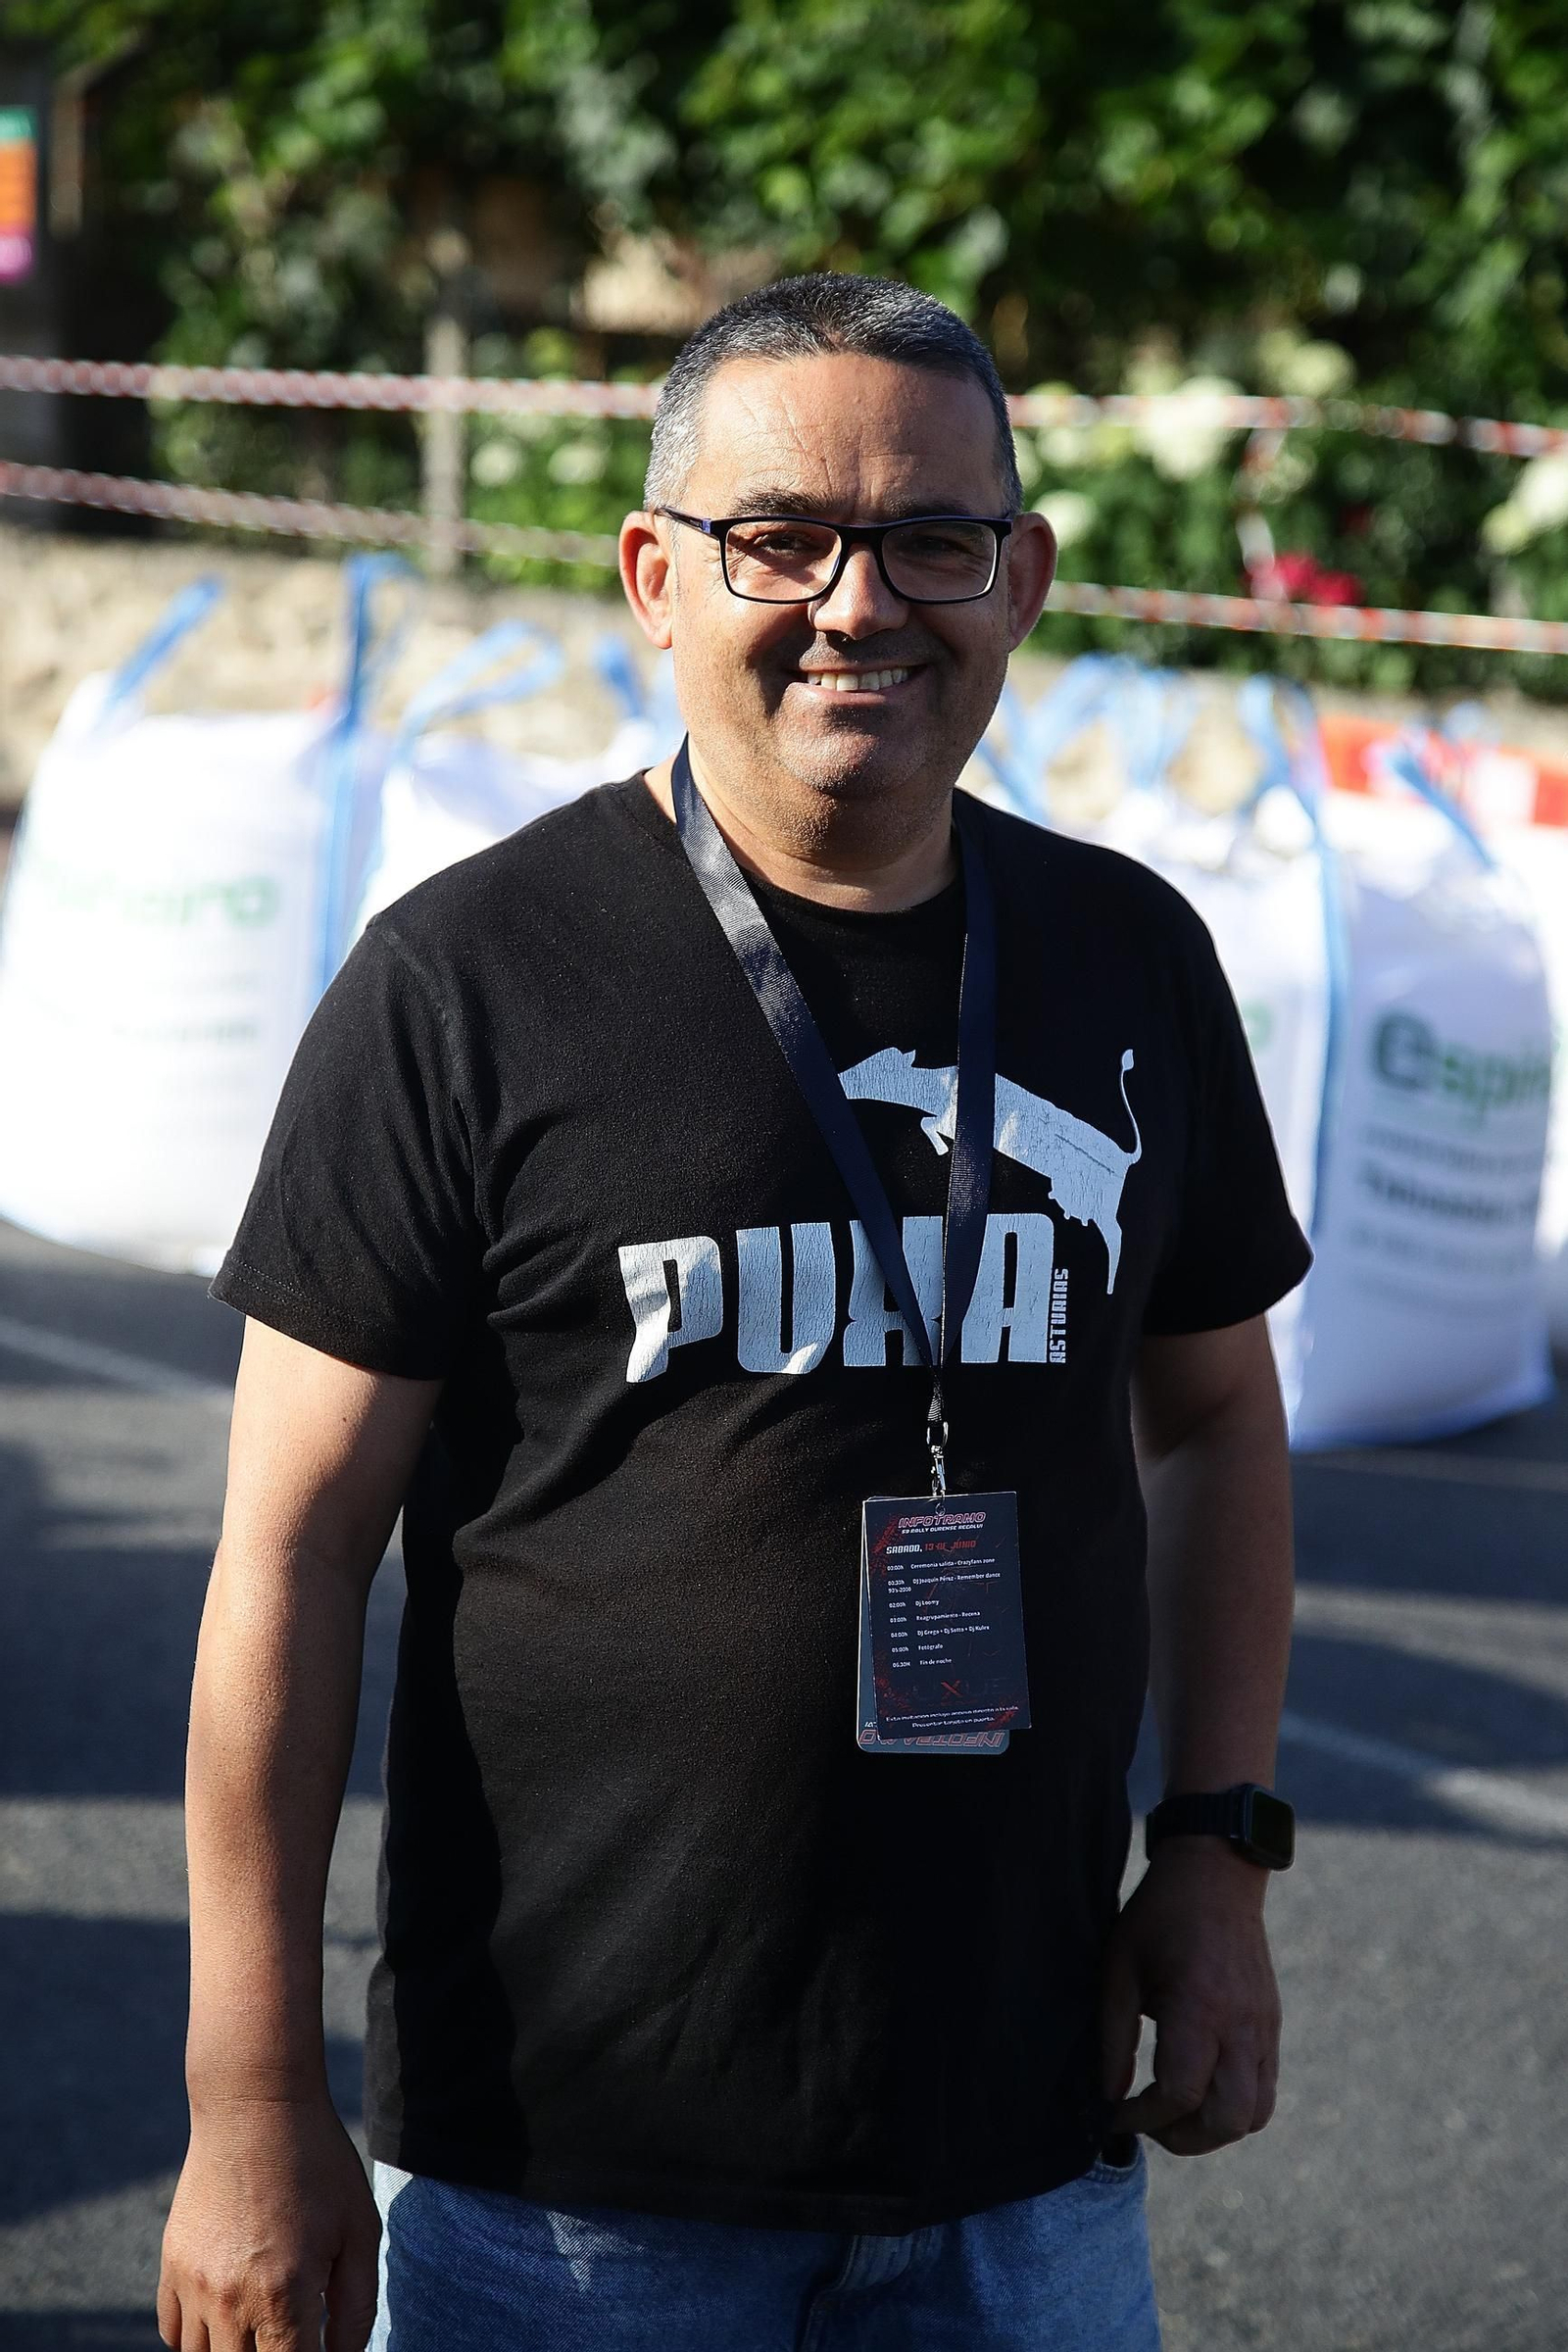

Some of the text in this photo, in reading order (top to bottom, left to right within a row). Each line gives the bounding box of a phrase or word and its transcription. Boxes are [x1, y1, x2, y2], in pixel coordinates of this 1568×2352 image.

[617, 1213, 1054, 1383] PUXA
[1049, 1268, 1069, 1363] ASTURIAS
[898, 1511, 987, 1529] INFOTRAMO
[936, 1656, 953, 1665] noche
